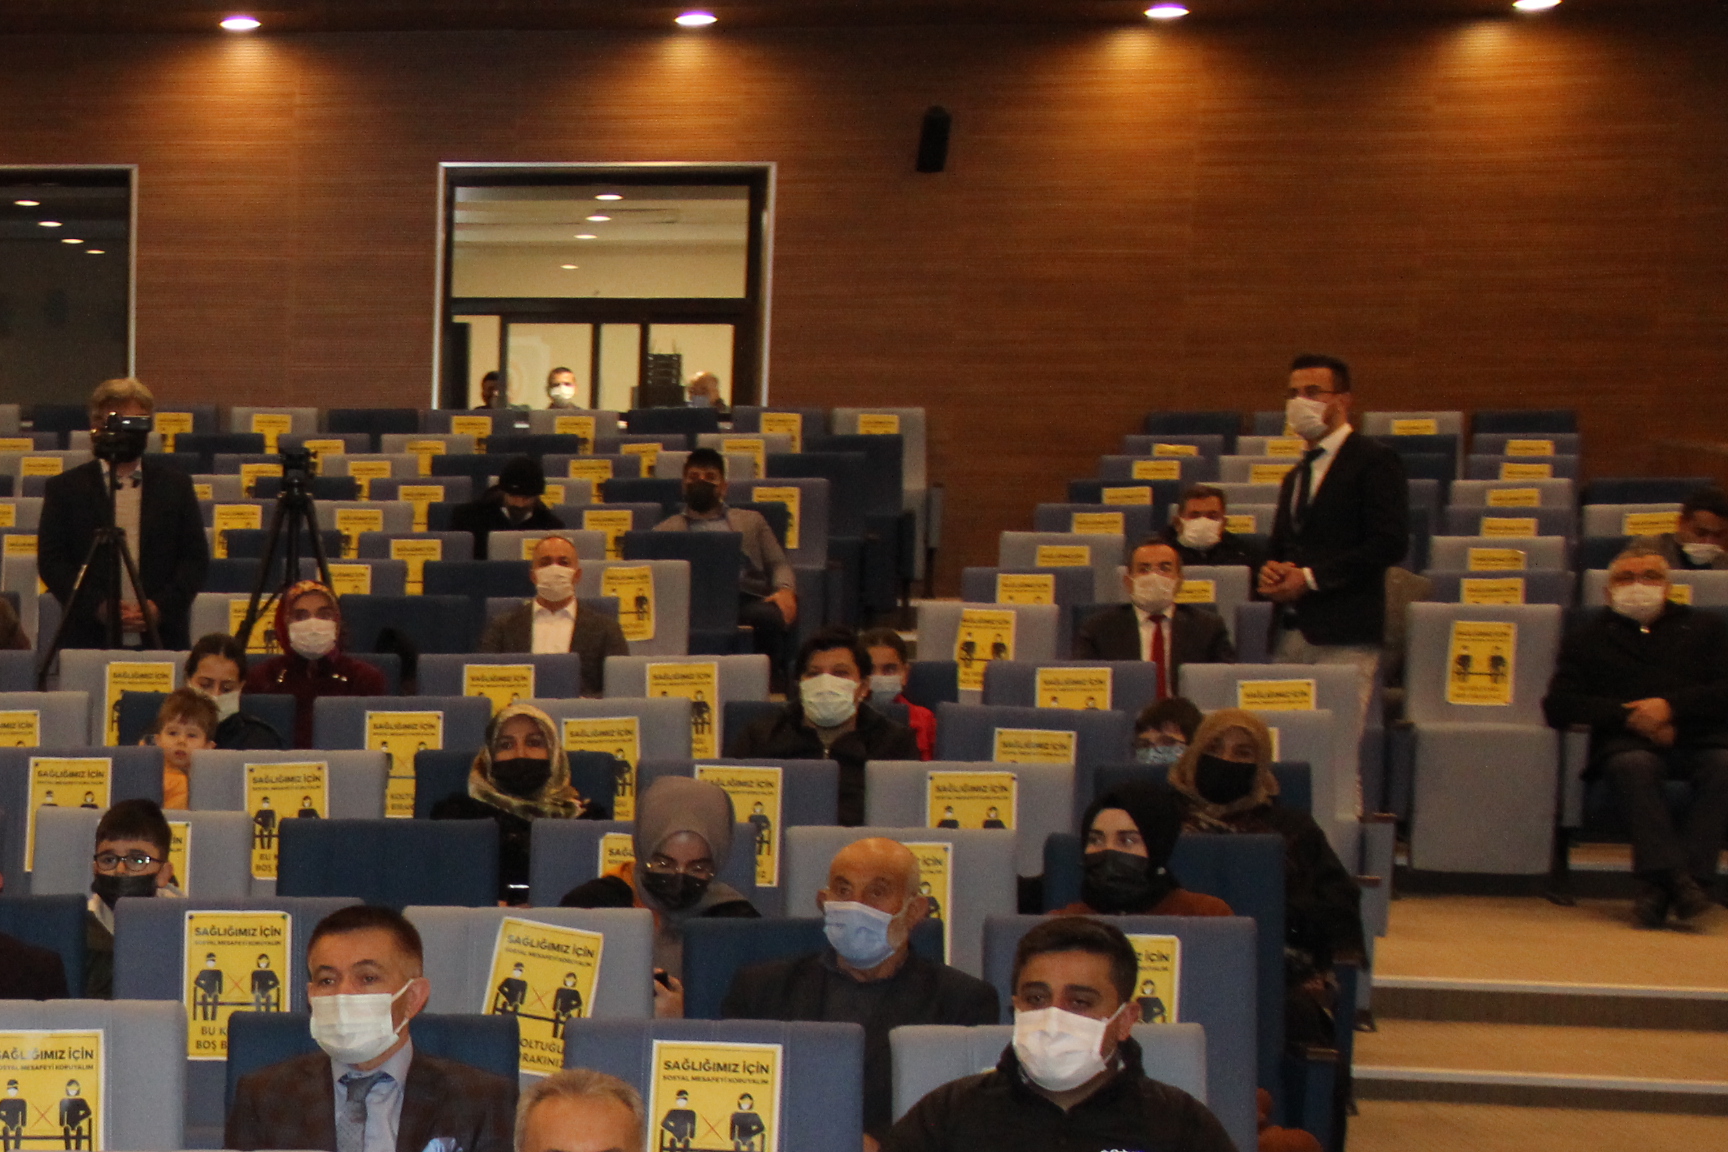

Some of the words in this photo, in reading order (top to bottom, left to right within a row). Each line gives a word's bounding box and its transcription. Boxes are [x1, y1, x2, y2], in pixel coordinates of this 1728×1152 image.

[194, 924, 258, 936] SAĞLIĞIMIZ
[260, 926, 282, 938] İÇİN
[506, 933, 570, 954] SAĞLIĞIMIZ
[572, 944, 595, 959] İÇİN
[202, 1026, 216, 1036] BU
[196, 1040, 217, 1052] BOŞ
[68, 1046, 94, 1062] İÇİN
[664, 1058, 740, 1073] SAĞLIĞIMIZ
[743, 1060, 770, 1076] İÇİN
